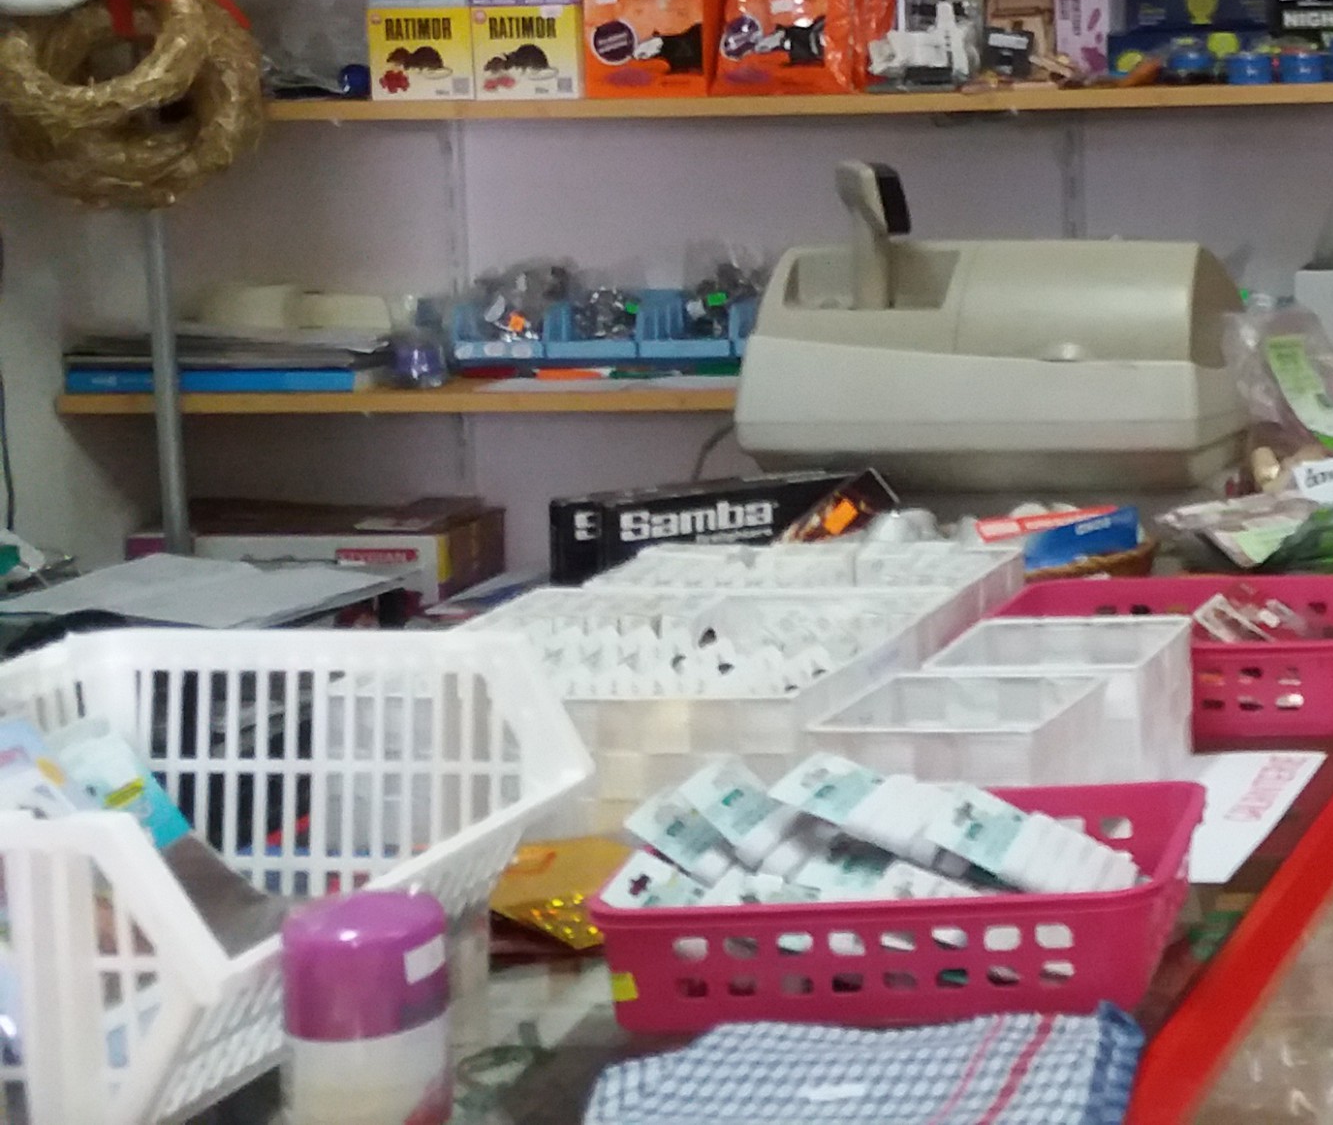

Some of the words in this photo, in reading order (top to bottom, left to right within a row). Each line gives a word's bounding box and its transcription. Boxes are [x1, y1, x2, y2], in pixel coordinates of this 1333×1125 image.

[385, 17, 452, 41] RATIMOR
[488, 16, 557, 40] RATIMOR
[620, 500, 774, 542] Samba
